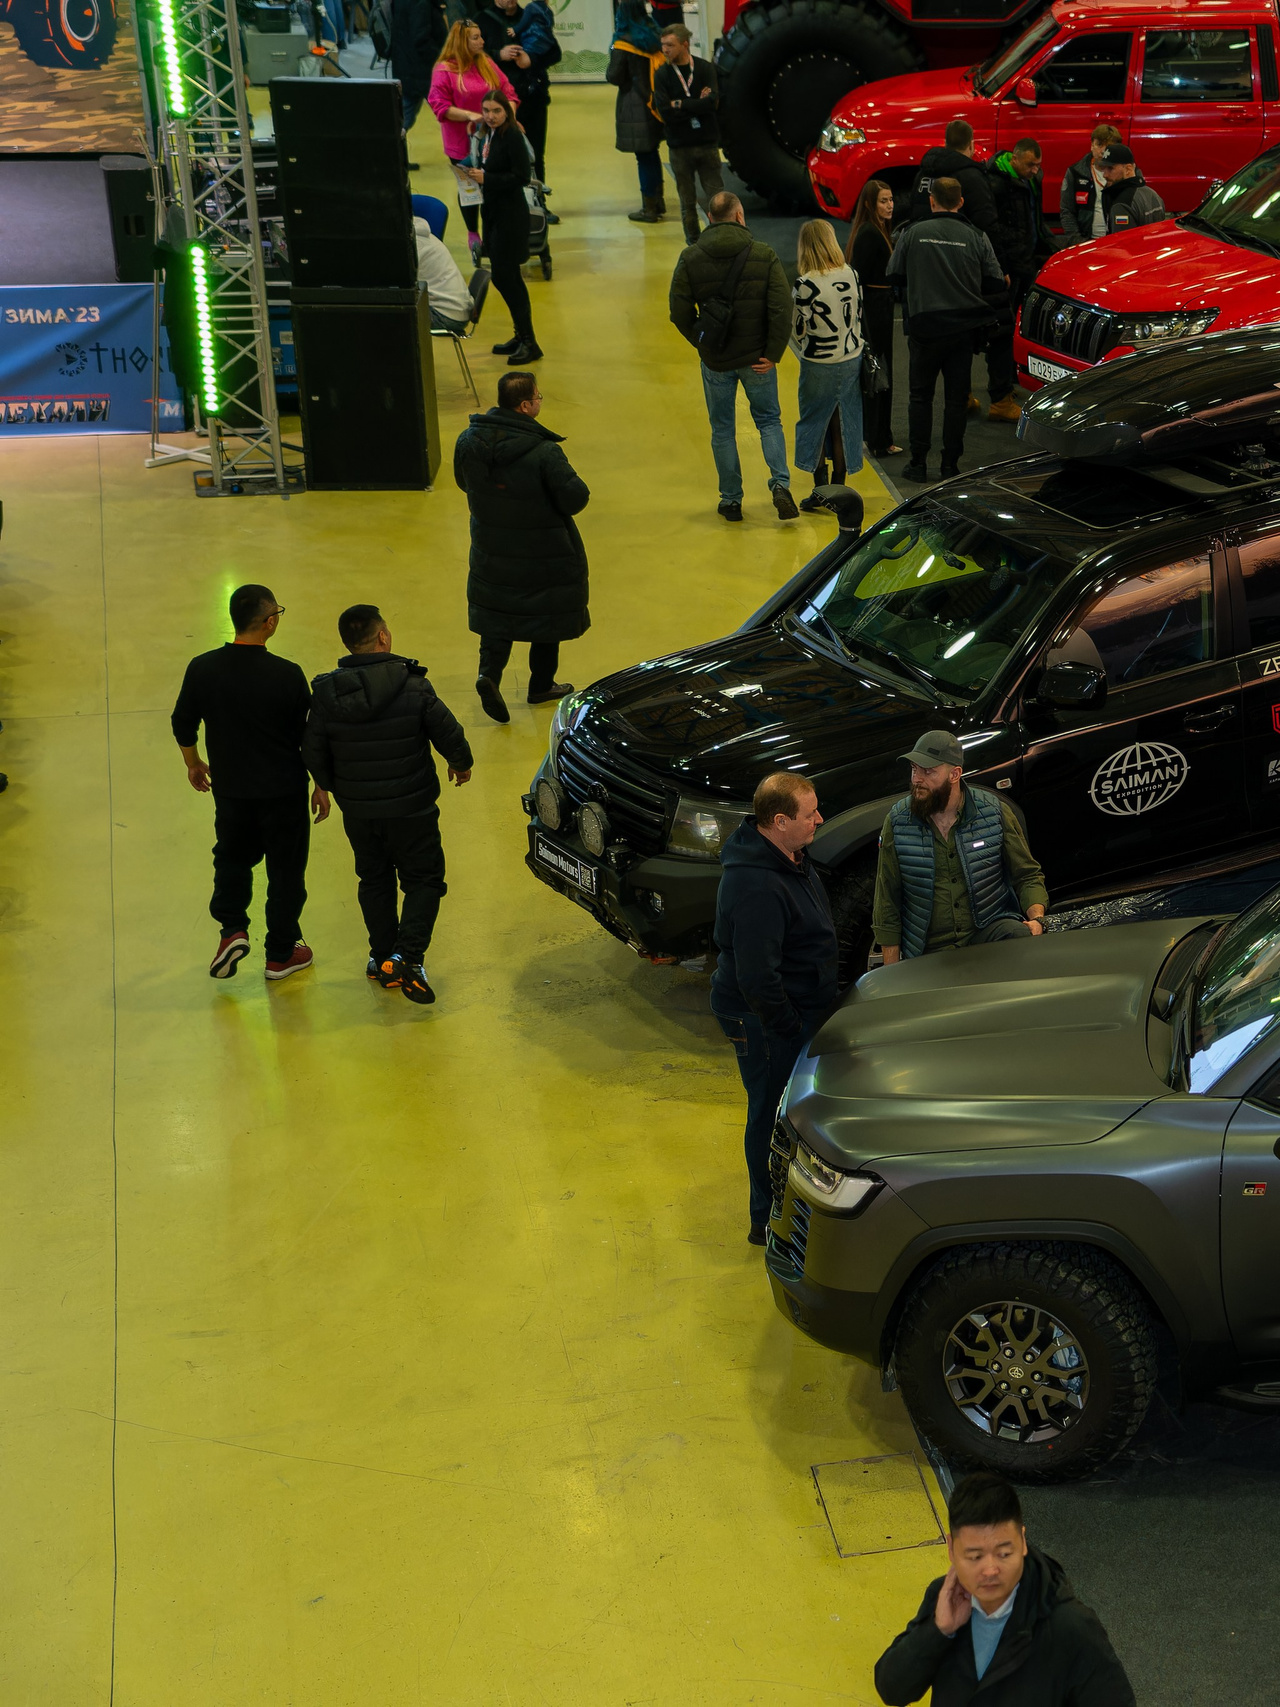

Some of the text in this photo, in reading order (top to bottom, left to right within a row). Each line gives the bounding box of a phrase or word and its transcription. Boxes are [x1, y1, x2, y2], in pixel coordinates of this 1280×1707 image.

[1101, 764, 1178, 795] SAIMAN
[1116, 783, 1163, 799] EXPEDITION
[558, 854, 579, 879] Motors
